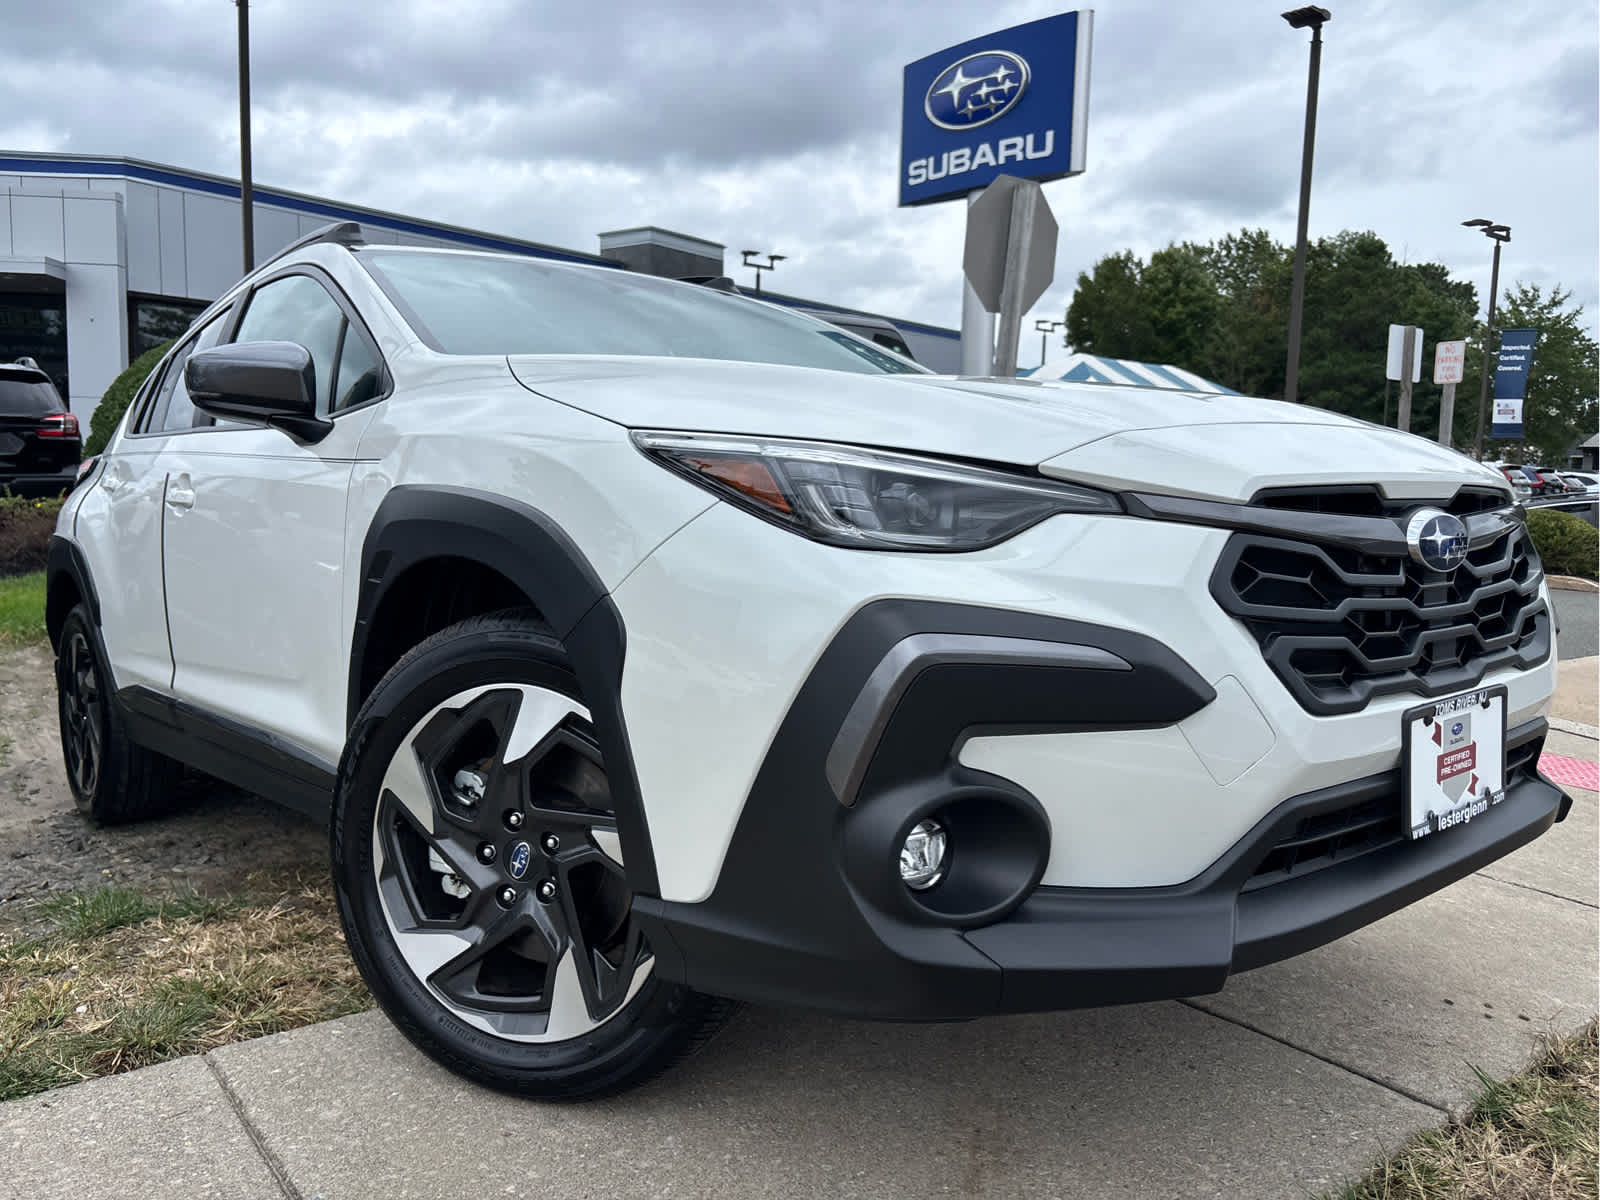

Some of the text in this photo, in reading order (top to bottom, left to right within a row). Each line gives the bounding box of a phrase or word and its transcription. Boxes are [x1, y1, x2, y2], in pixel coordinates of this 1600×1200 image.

[908, 130, 1055, 186] SUBARU
[1435, 700, 1455, 716] TOMS
[1479, 690, 1488, 704] NJ
[1440, 759, 1473, 777] PRE-OWNED
[1443, 750, 1470, 766] CERTIFIED
[1437, 799, 1488, 832] lesterglenn
